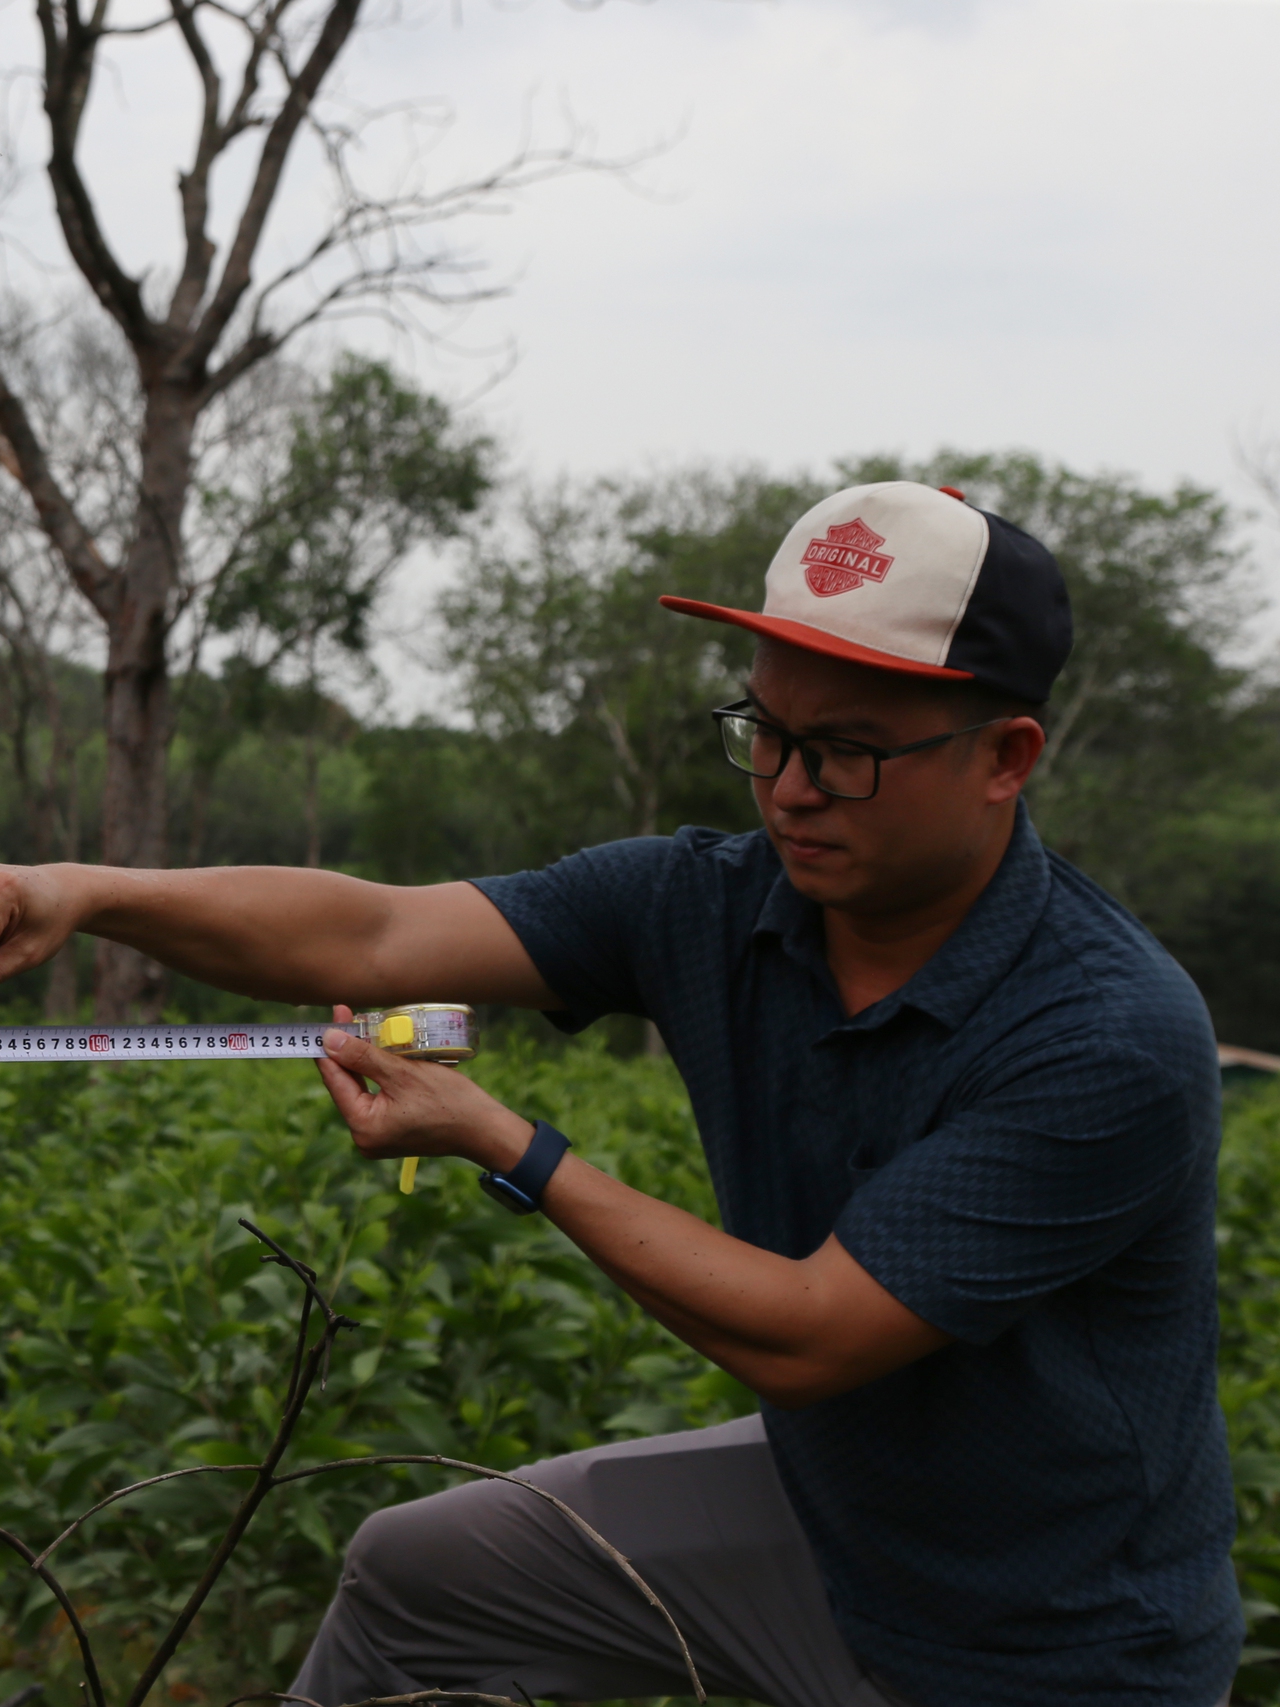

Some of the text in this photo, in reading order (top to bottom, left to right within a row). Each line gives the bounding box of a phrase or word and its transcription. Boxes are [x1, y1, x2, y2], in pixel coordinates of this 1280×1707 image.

[807, 545, 881, 576] ORIGINAL
[8, 1039, 17, 1050] 4
[23, 1039, 31, 1050] 5
[37, 1038, 45, 1050] 6
[52, 1038, 60, 1049] 7
[66, 1038, 74, 1049] 8
[79, 1038, 87, 1049] 9
[91, 1036, 108, 1050] 190
[110, 1038, 115, 1049] 1
[123, 1038, 131, 1048] 2
[137, 1037, 145, 1048] 3
[151, 1037, 160, 1048] 4
[165, 1037, 173, 1048] 5
[179, 1037, 187, 1048] 6
[193, 1037, 201, 1048] 7
[207, 1037, 215, 1048] 8
[220, 1037, 228, 1048] 9
[230, 1035, 247, 1049] 200
[249, 1037, 254, 1047] 1
[262, 1036, 270, 1047] 2
[275, 1036, 283, 1047] 3
[288, 1036, 296, 1046] 4
[302, 1036, 310, 1046] 5
[315, 1036, 323, 1046] 6
